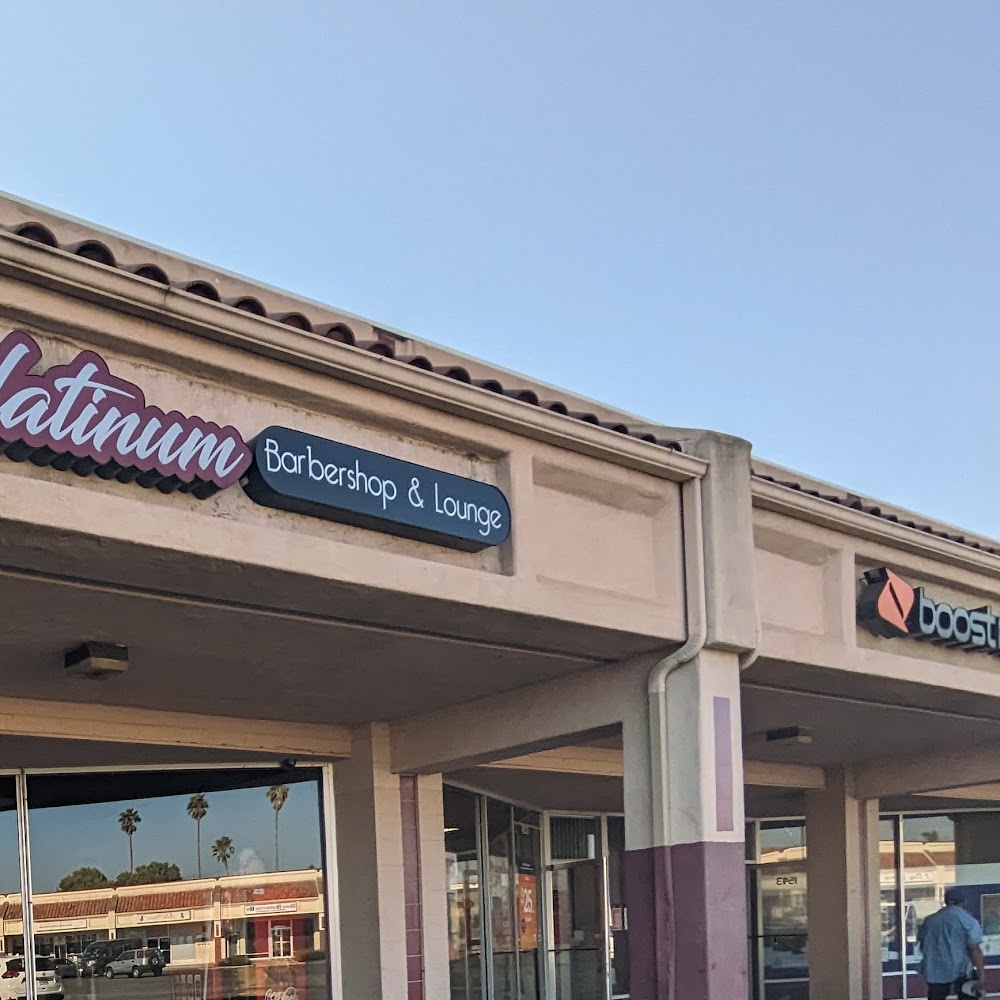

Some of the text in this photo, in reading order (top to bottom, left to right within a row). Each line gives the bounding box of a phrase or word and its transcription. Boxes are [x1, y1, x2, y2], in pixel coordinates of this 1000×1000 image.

[264, 438, 501, 536] Barbershop & Lounge
[919, 587, 997, 648] boost
